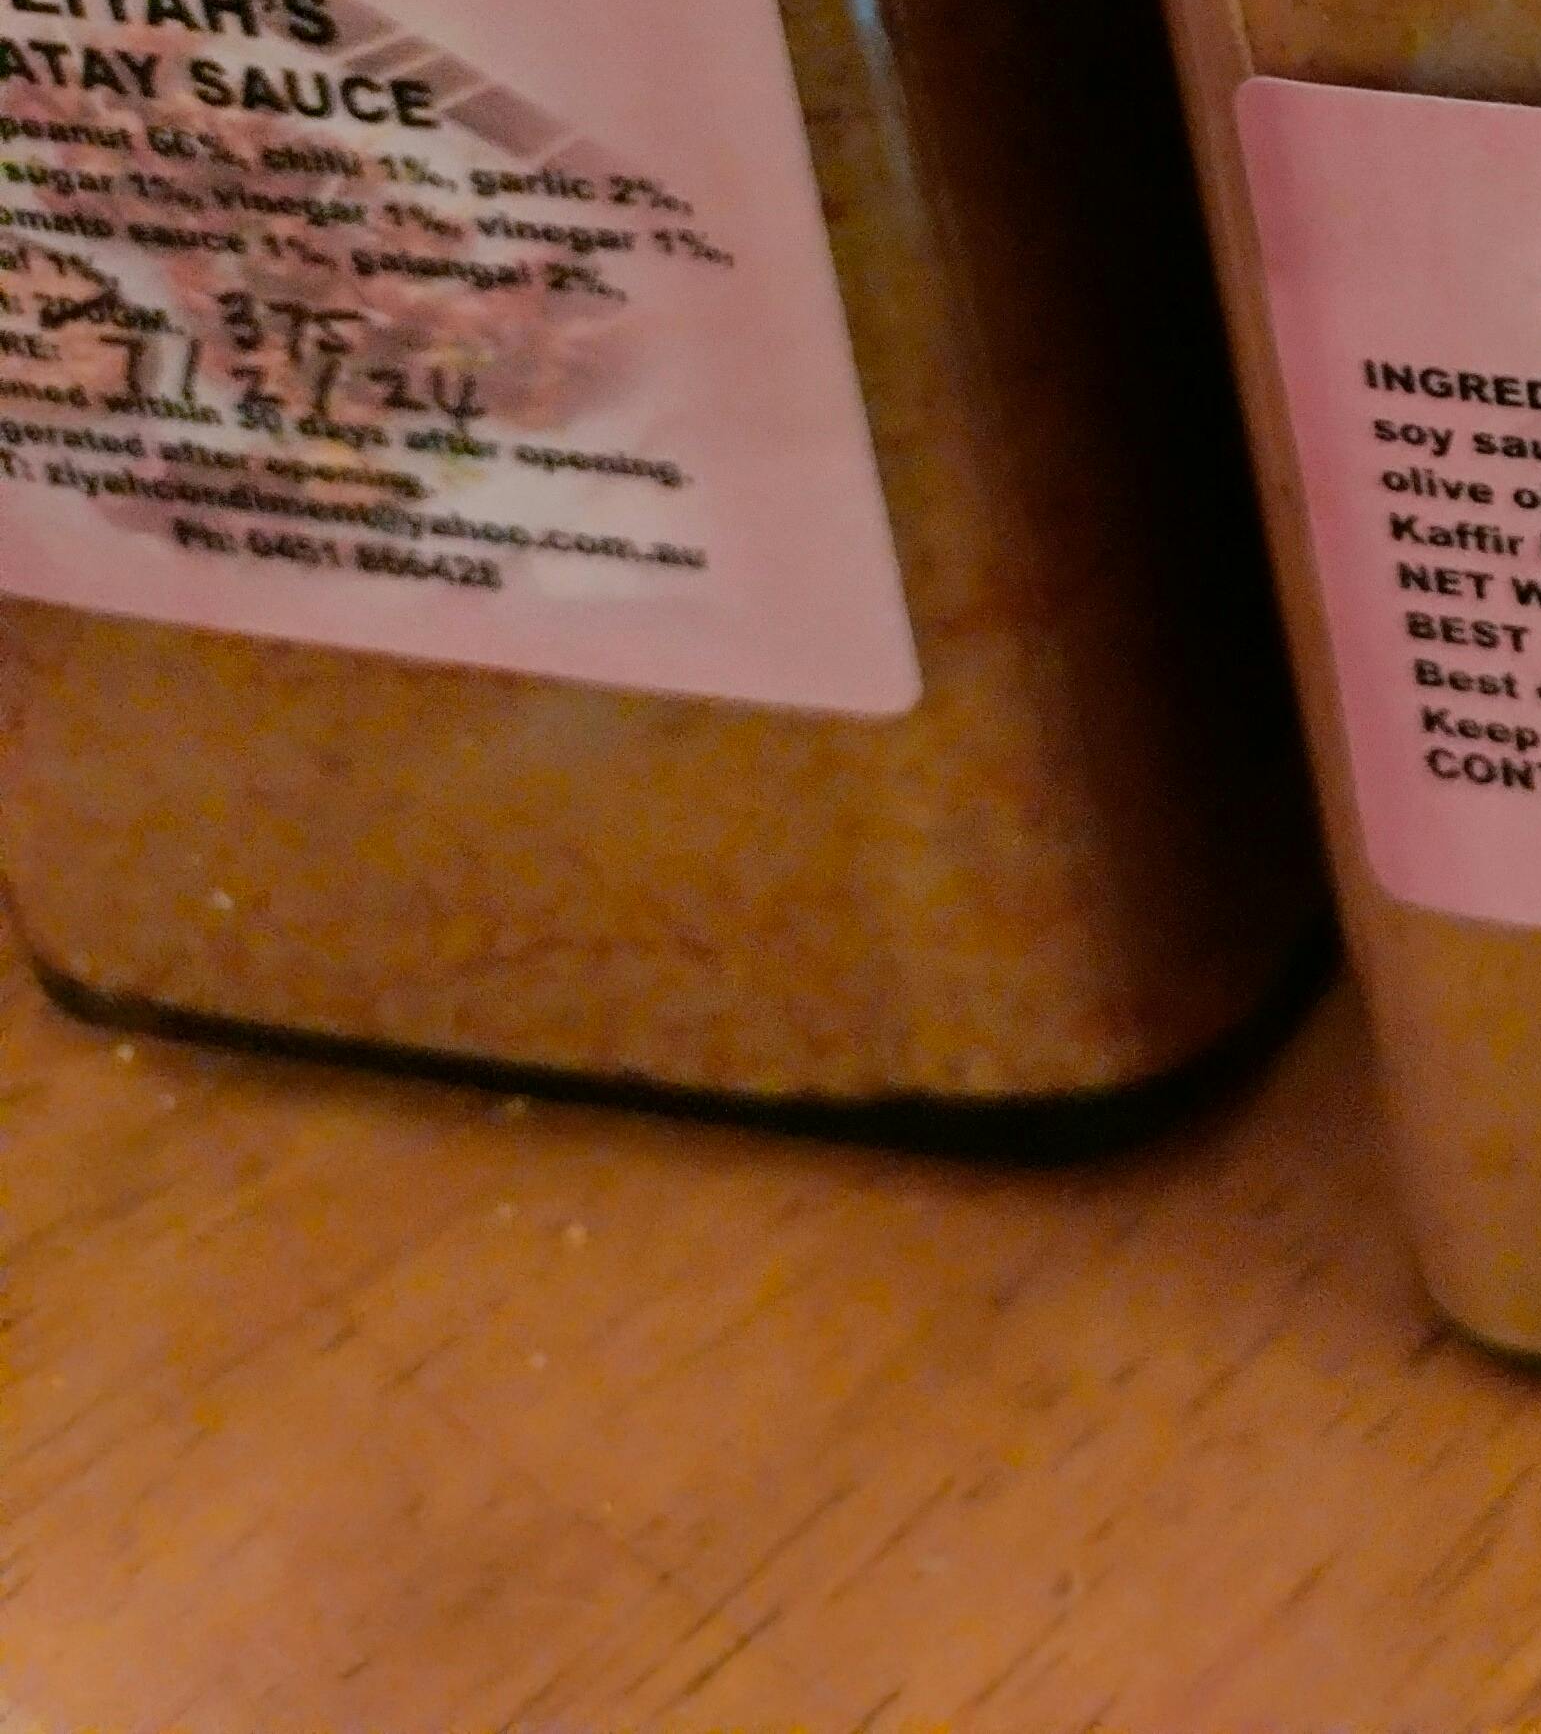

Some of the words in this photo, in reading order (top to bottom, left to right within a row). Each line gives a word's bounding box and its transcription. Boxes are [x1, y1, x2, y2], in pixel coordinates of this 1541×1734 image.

[190, 59, 441, 130] SAUCE
[216, 289, 366, 363] 375
[1373, 418, 1453, 455] soy
[1381, 467, 1495, 504] olive
[1389, 512, 1524, 557] Kaffir
[1398, 562, 1493, 599] NET
[1406, 612, 1530, 653] BEST
[1414, 659, 1518, 700] Best
[1420, 706, 1538, 753] Keep
